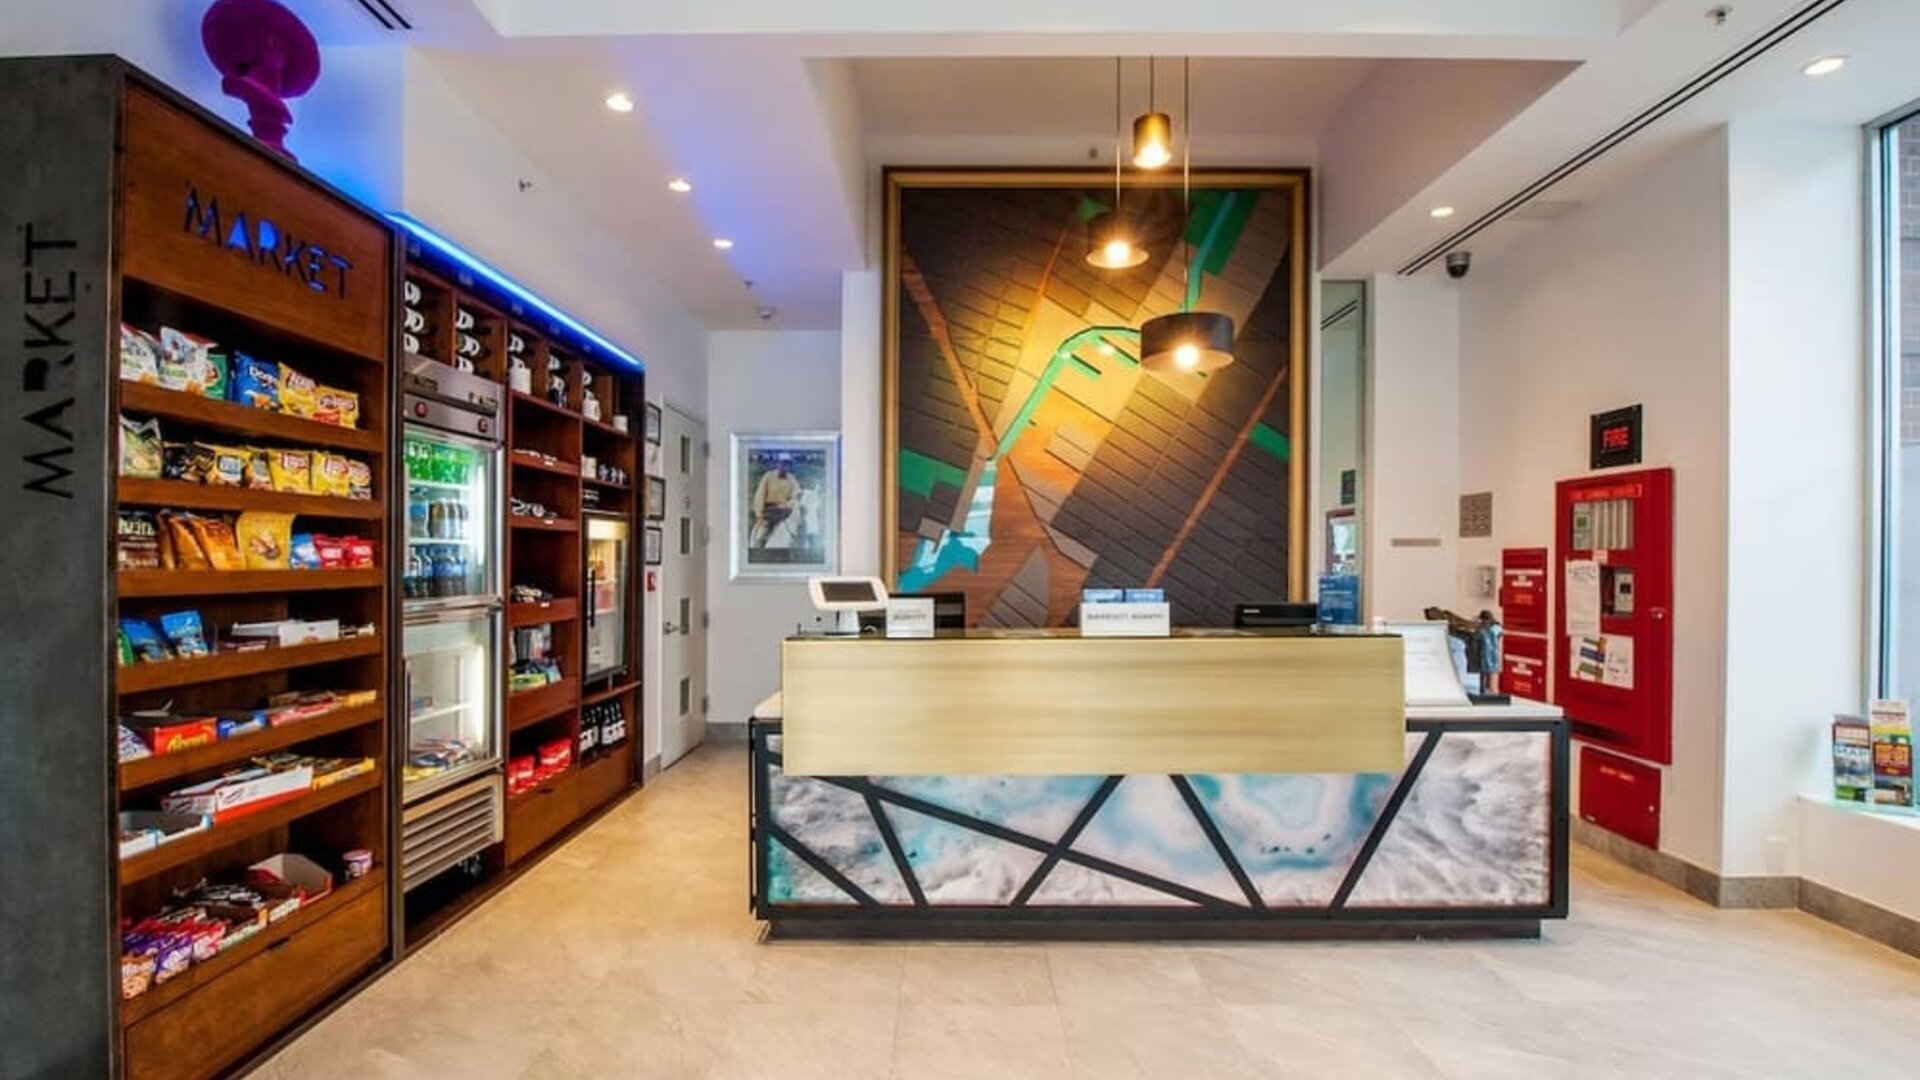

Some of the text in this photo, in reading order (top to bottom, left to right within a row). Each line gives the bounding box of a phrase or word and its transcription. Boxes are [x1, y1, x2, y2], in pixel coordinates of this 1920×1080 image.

[183, 182, 354, 300] MARKET
[22, 222, 78, 499] MARKET
[1602, 426, 1630, 449] FIRE
